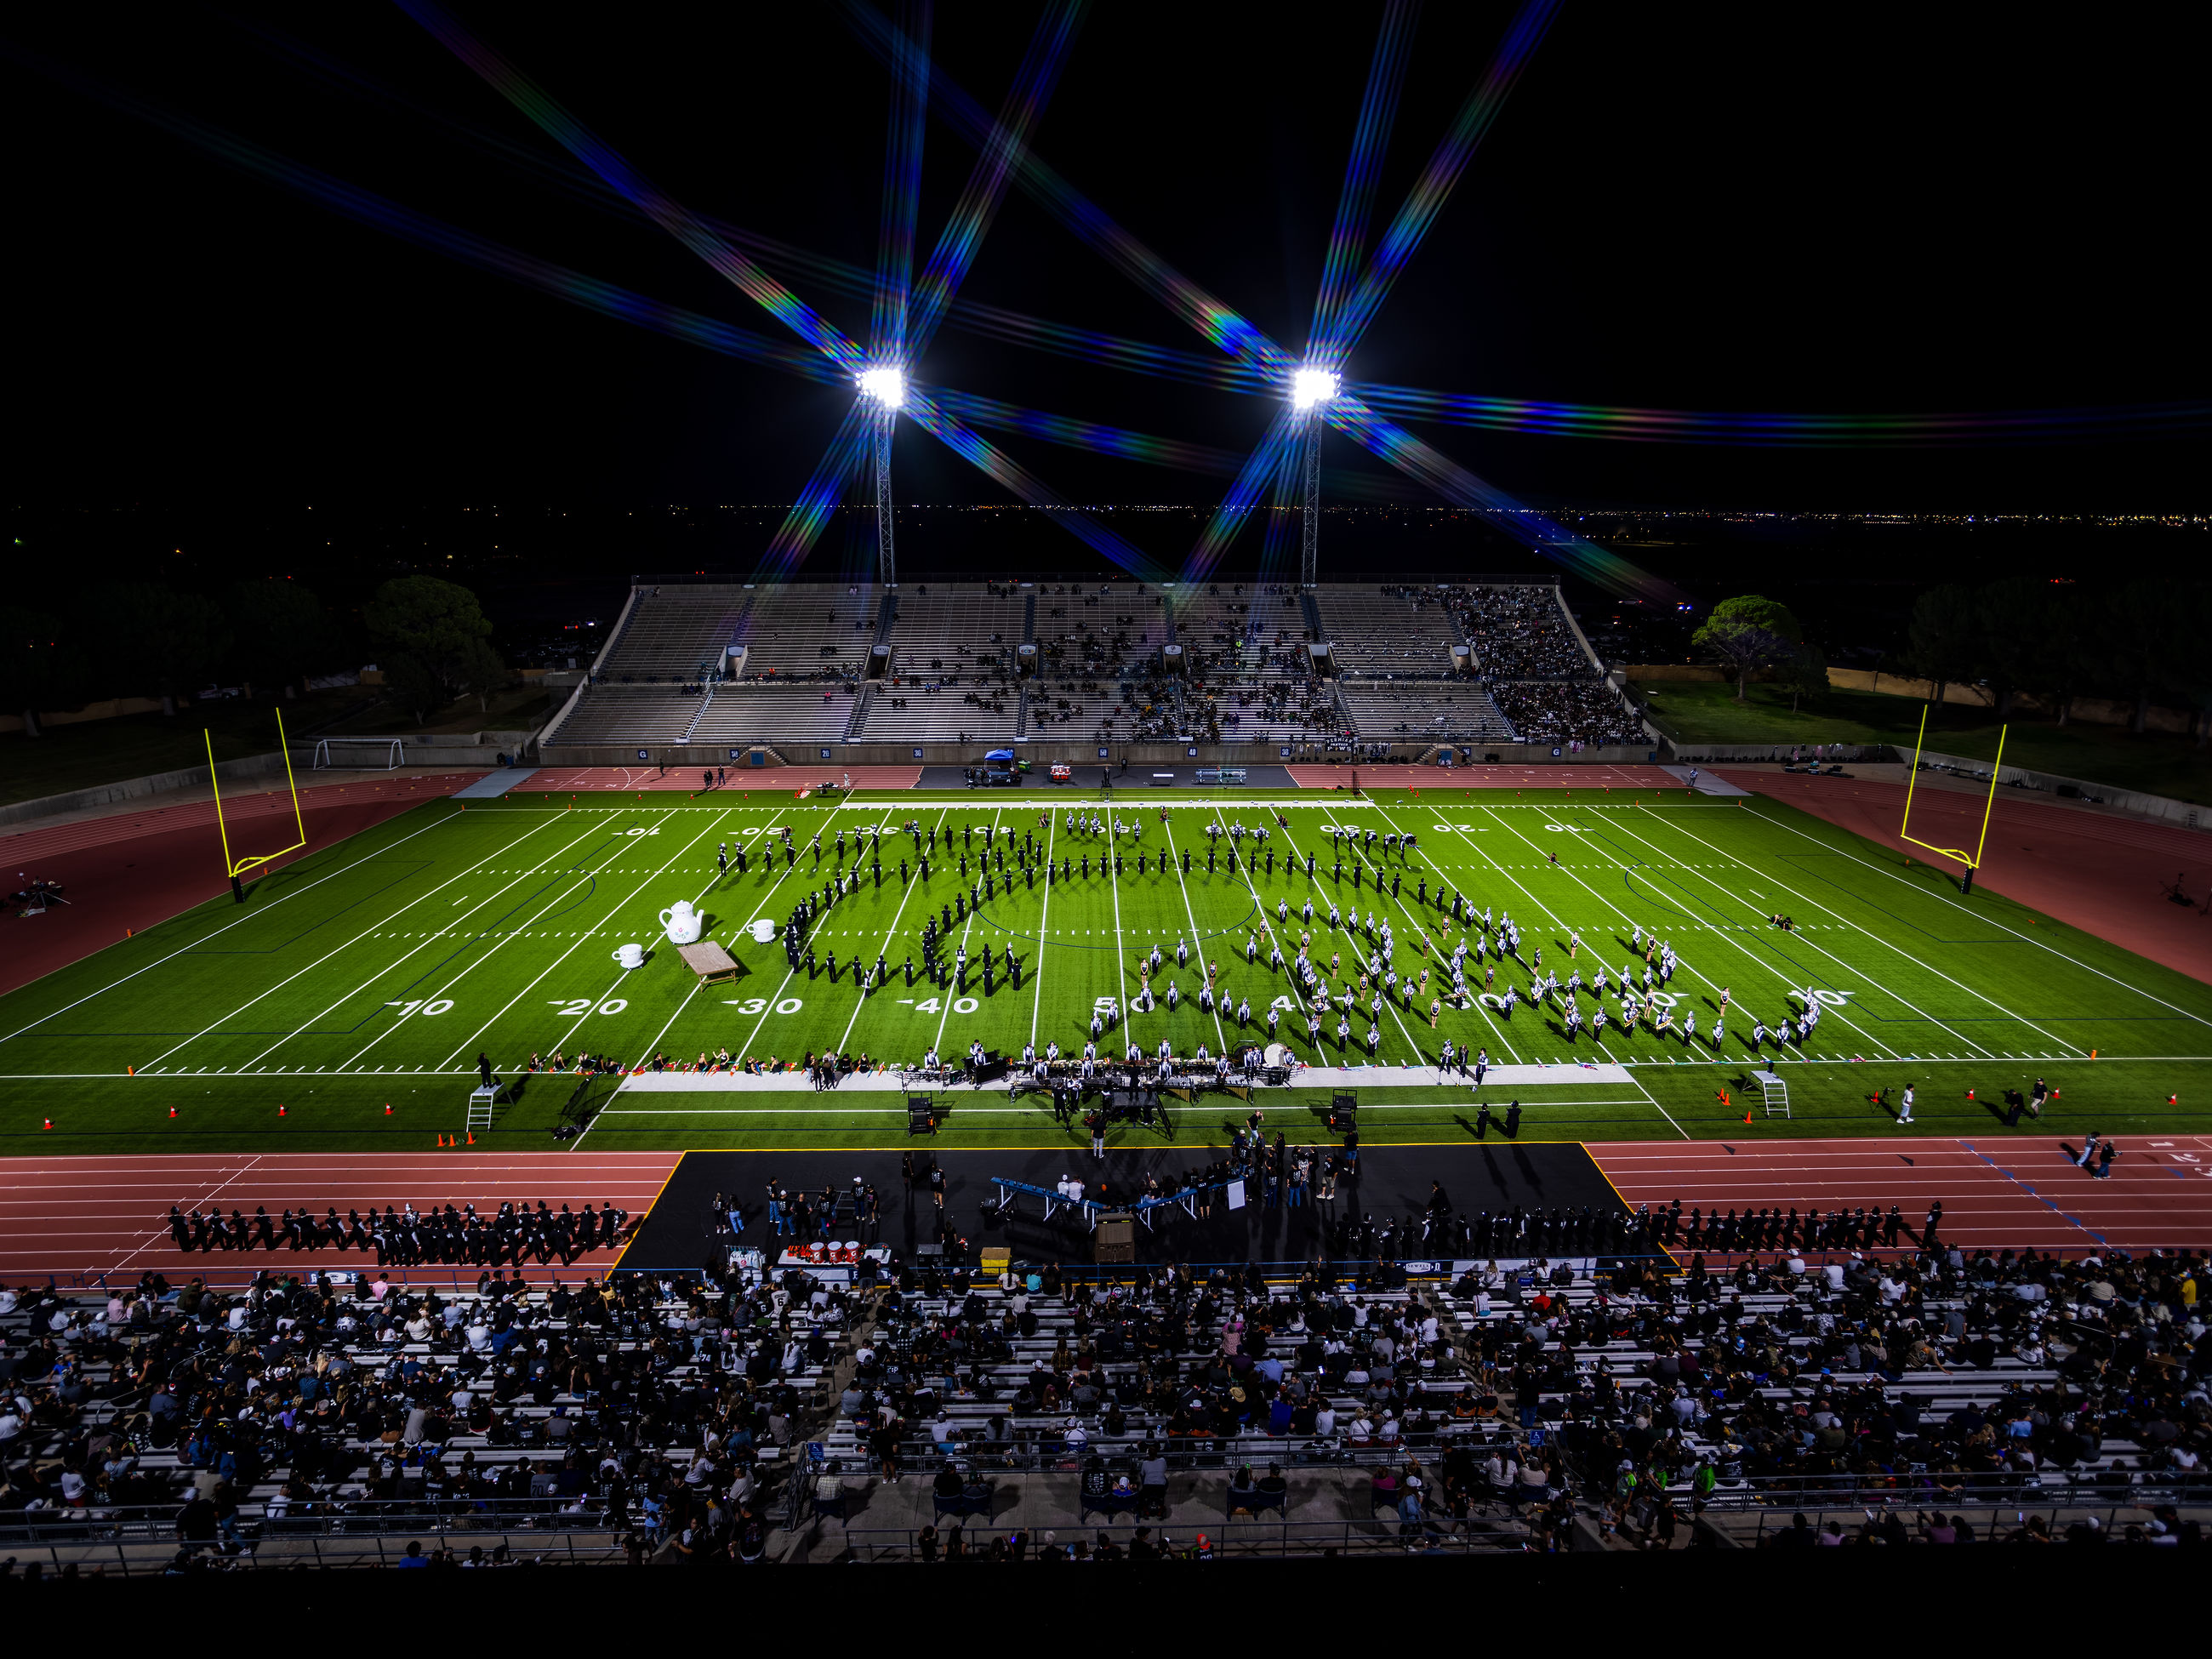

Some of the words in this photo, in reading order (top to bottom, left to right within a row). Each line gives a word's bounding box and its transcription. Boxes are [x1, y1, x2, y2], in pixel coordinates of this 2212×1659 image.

[626, 828, 660, 836] 10
[915, 997, 979, 1014] 40
[1092, 996, 1155, 1013] 50
[1787, 989, 1847, 1006] 10
[397, 1000, 454, 1016] 10
[556, 999, 628, 1015] 20
[738, 998, 803, 1014] 30
[760, 1304, 767, 1313] 6
[778, 1298, 784, 1307] 6
